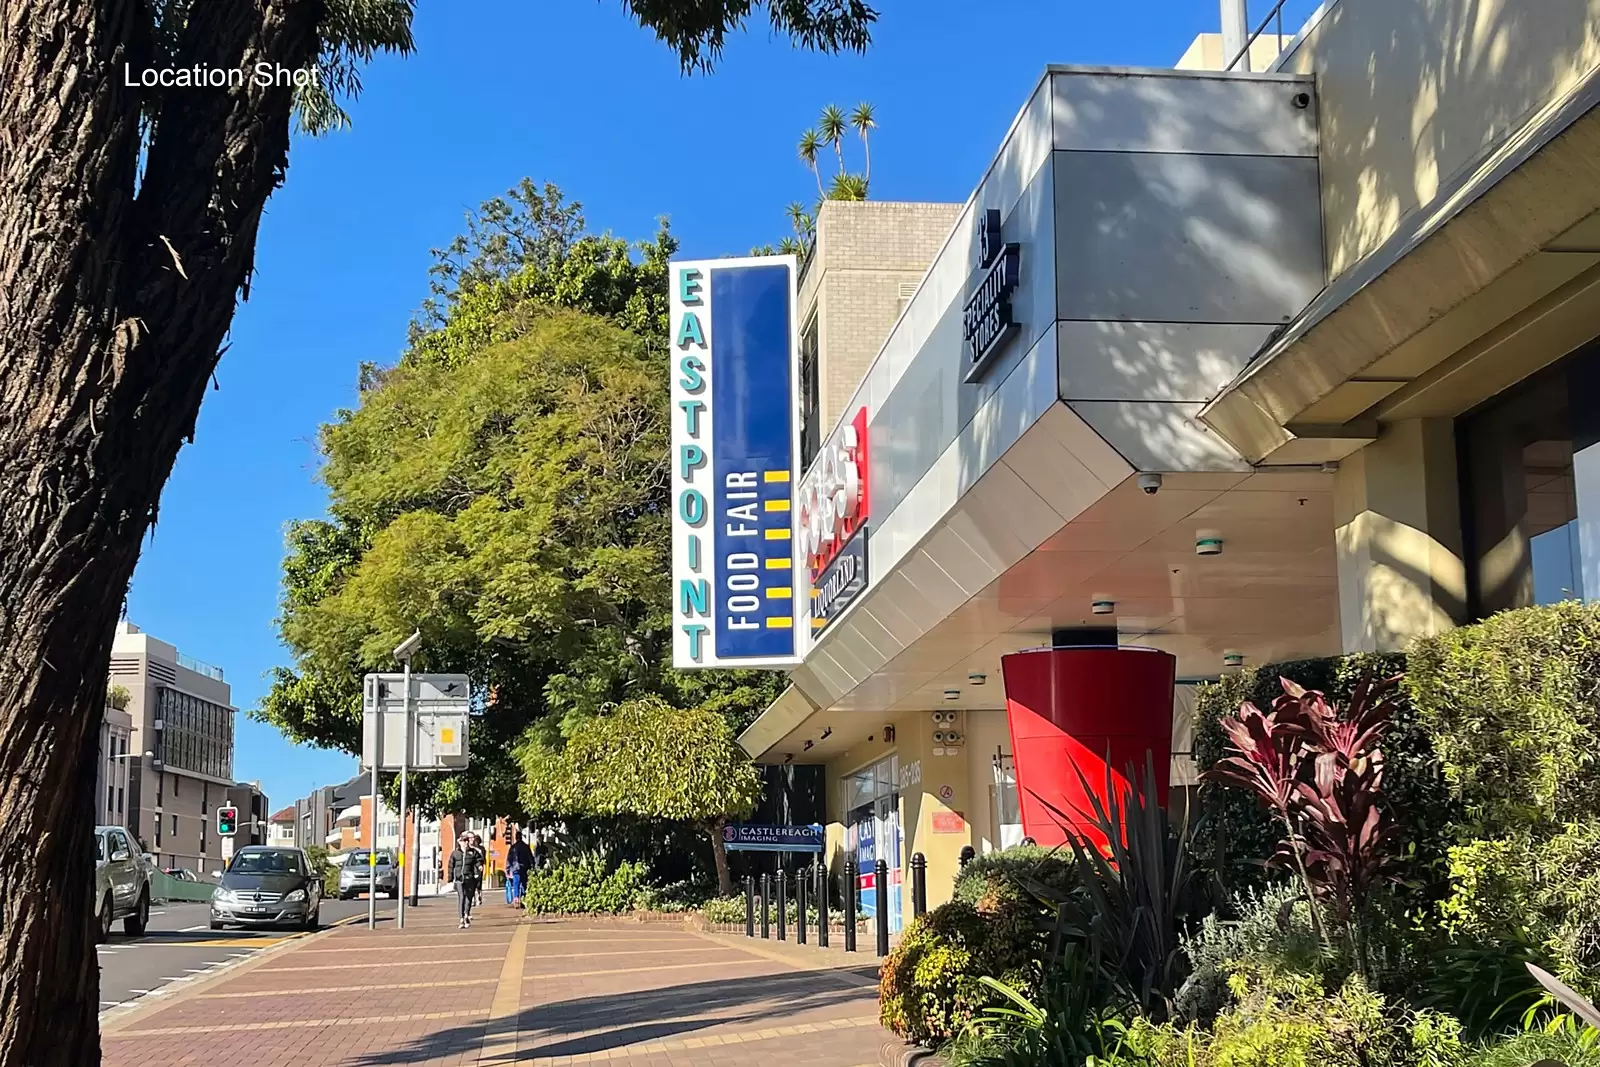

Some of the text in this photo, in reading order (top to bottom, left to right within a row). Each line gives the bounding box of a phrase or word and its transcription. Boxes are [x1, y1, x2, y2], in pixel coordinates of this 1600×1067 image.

[963, 254, 1008, 340] SPECIALITY
[970, 301, 1000, 363] STORES
[677, 268, 708, 660] EASTPOINT
[726, 470, 760, 631] FOOD FAIR
[814, 554, 855, 618] LIQUORLAND
[741, 827, 818, 837] CASTLEREAGH
